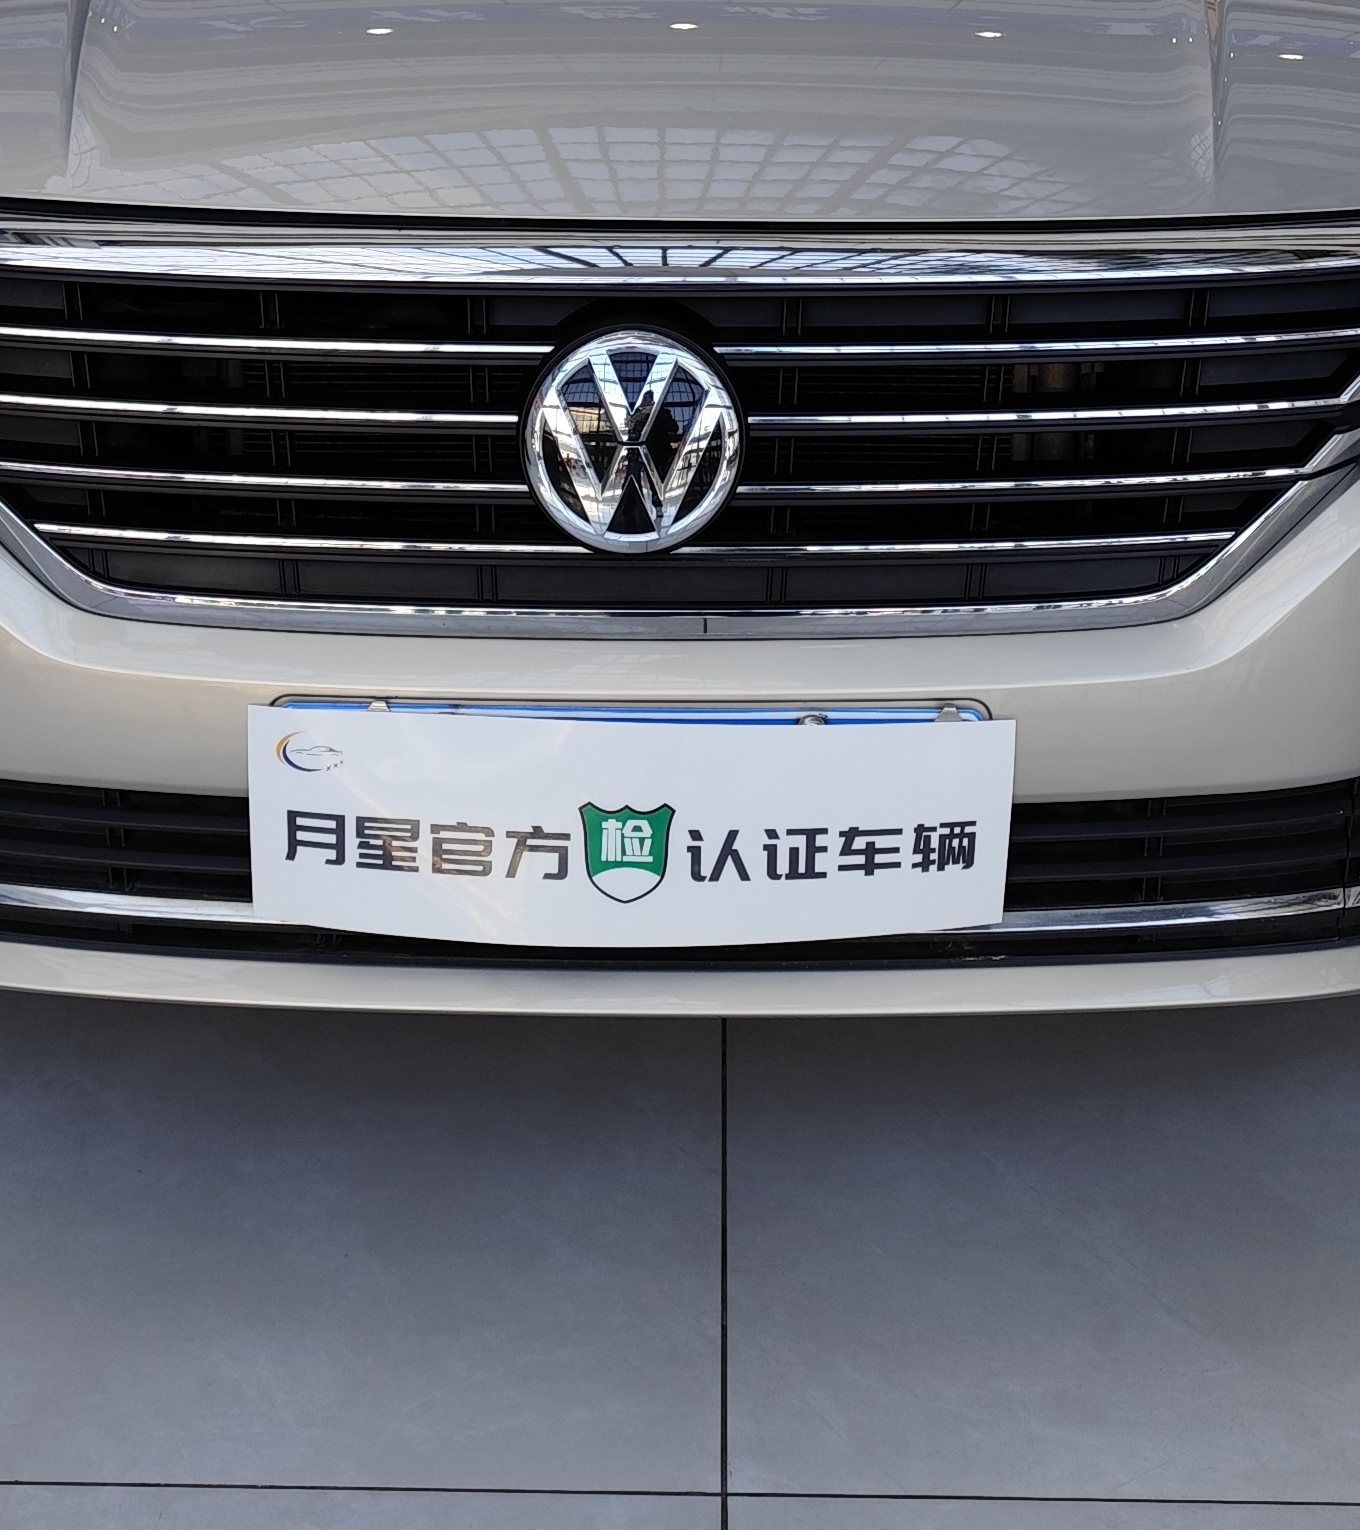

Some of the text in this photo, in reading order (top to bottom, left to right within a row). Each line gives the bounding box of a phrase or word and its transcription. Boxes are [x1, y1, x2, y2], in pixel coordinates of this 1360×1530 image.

[285, 809, 978, 883] 月星官方 检 认证车辆
